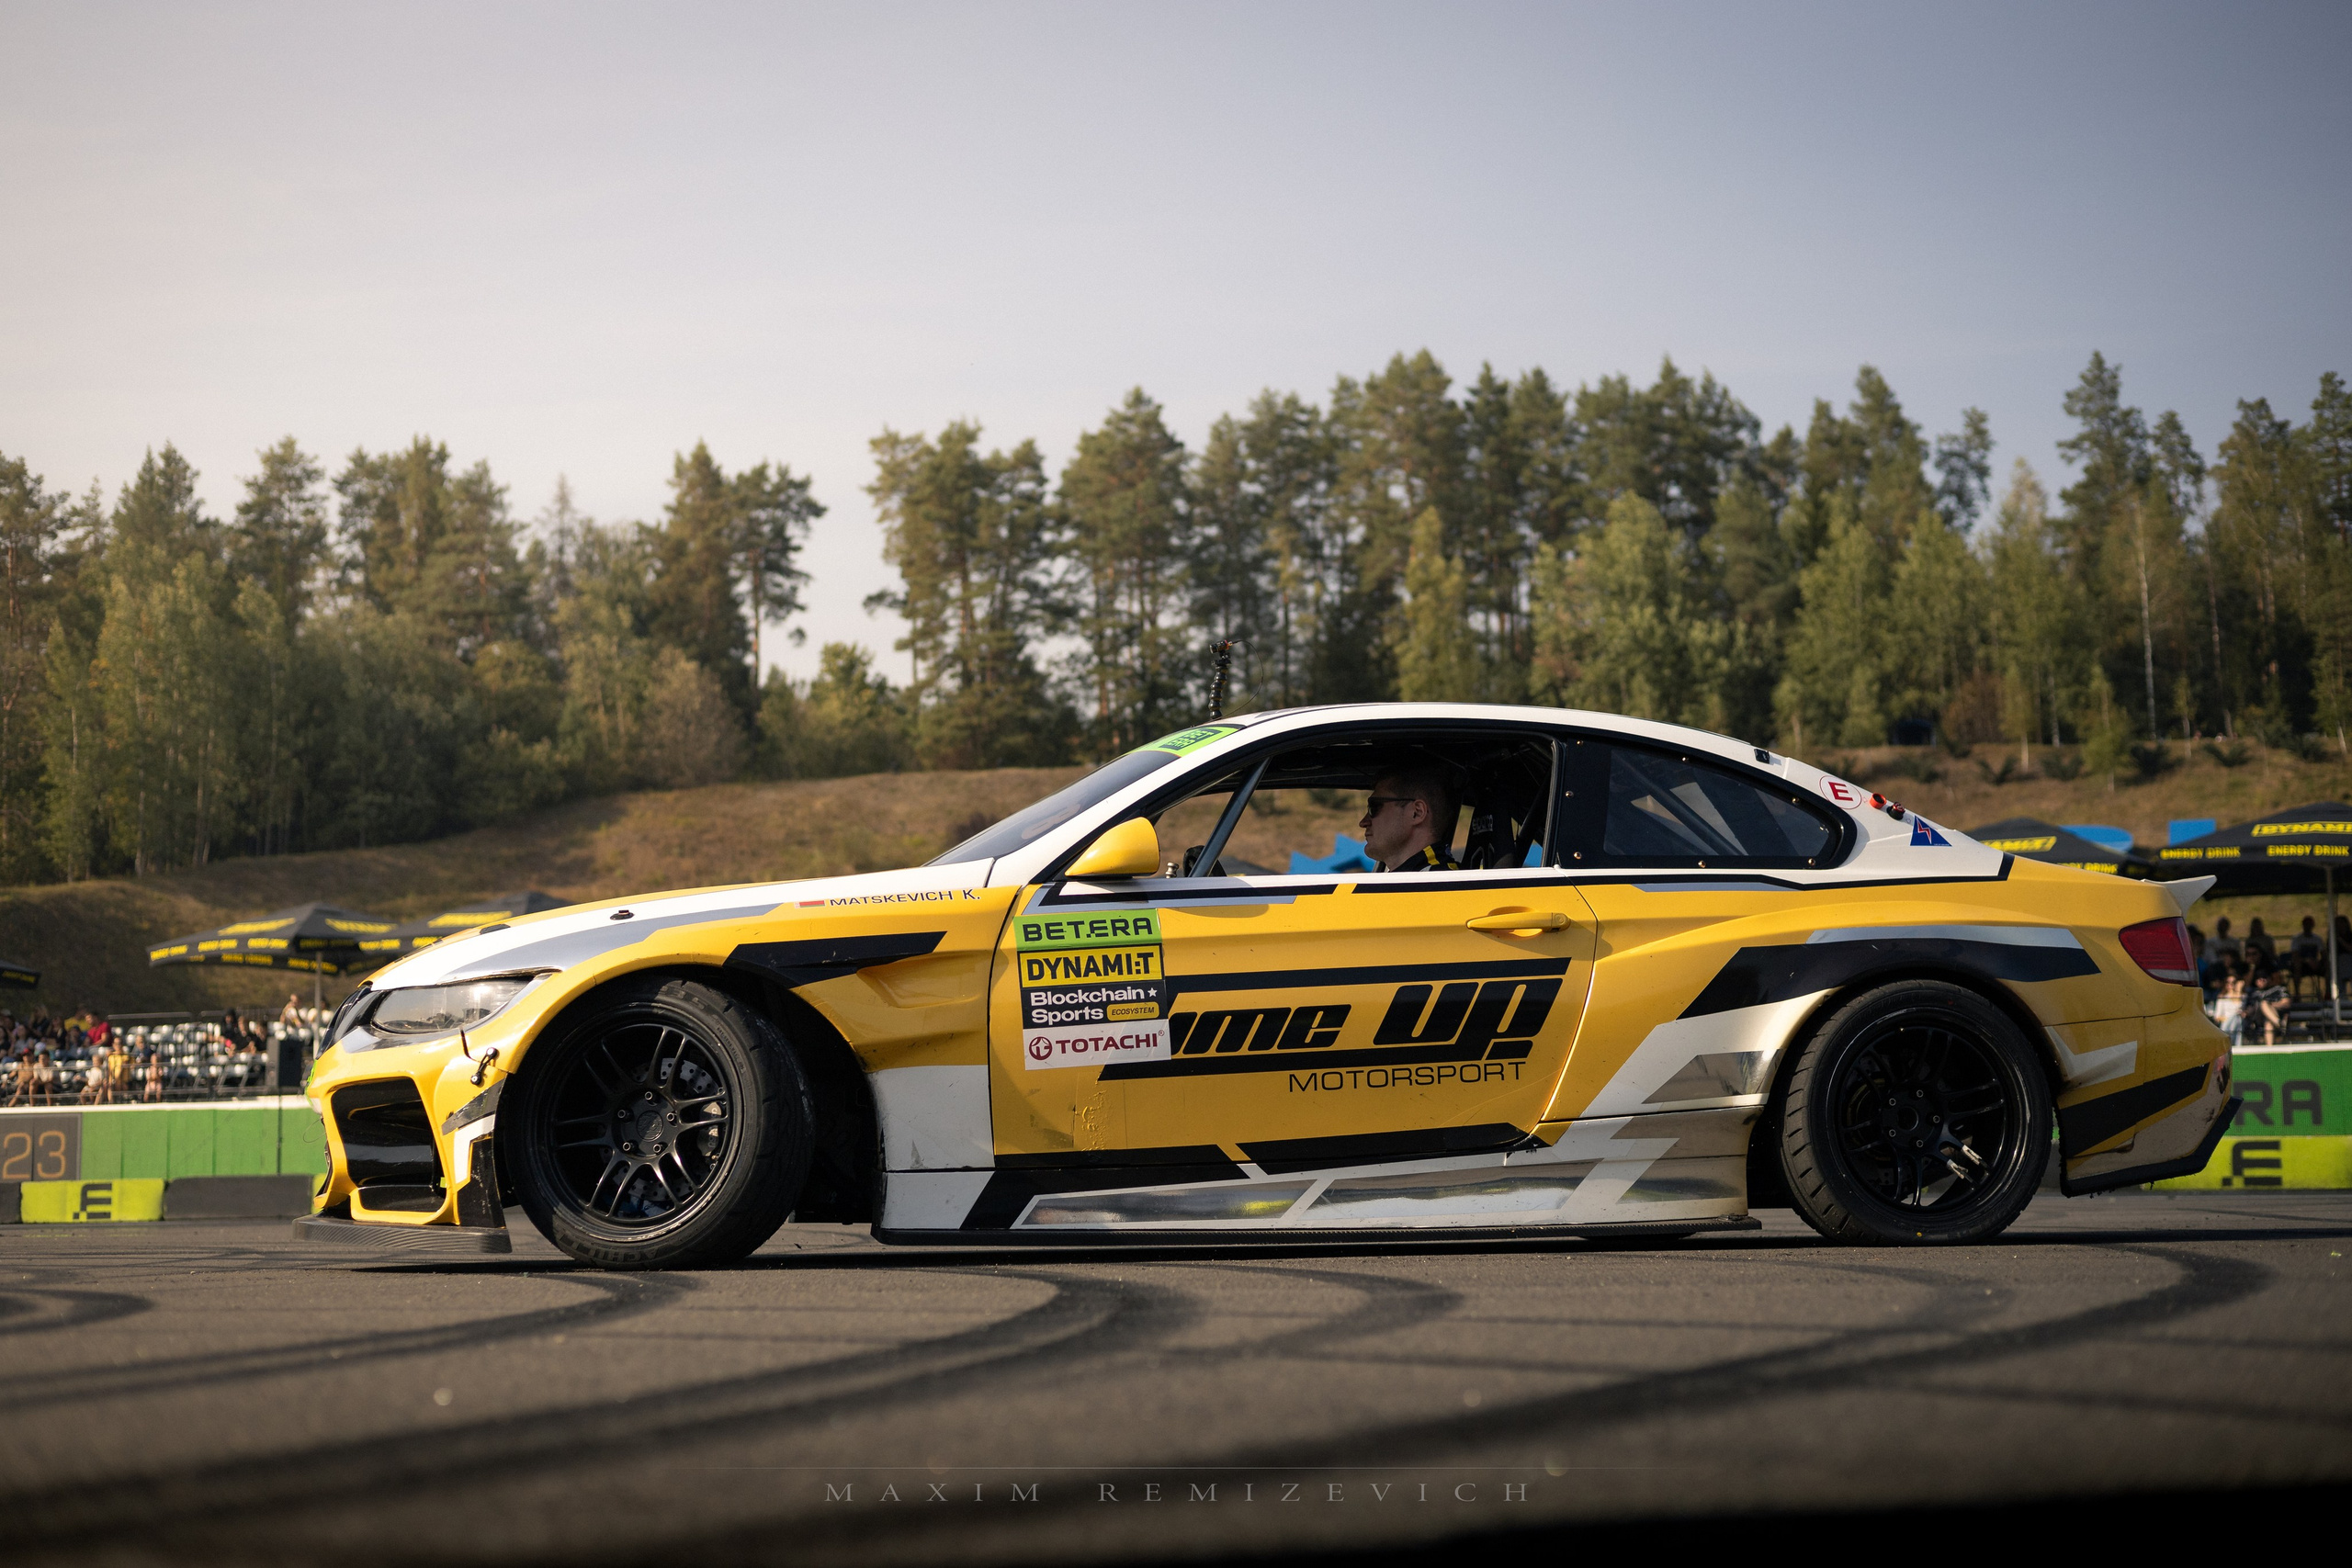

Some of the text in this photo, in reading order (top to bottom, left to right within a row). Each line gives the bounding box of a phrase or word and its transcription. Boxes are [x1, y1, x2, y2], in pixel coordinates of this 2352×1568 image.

[1828, 782, 1853, 801] E
[2267, 844, 2349, 856] ENERGY DRINK
[830, 888, 981, 907] MATSKEVICH K.
[1030, 987, 1146, 1007] Blockchain
[1031, 1006, 1155, 1026] Sports ECOSYSTEM
[1289, 1061, 1526, 1092] MOTORSPORT
